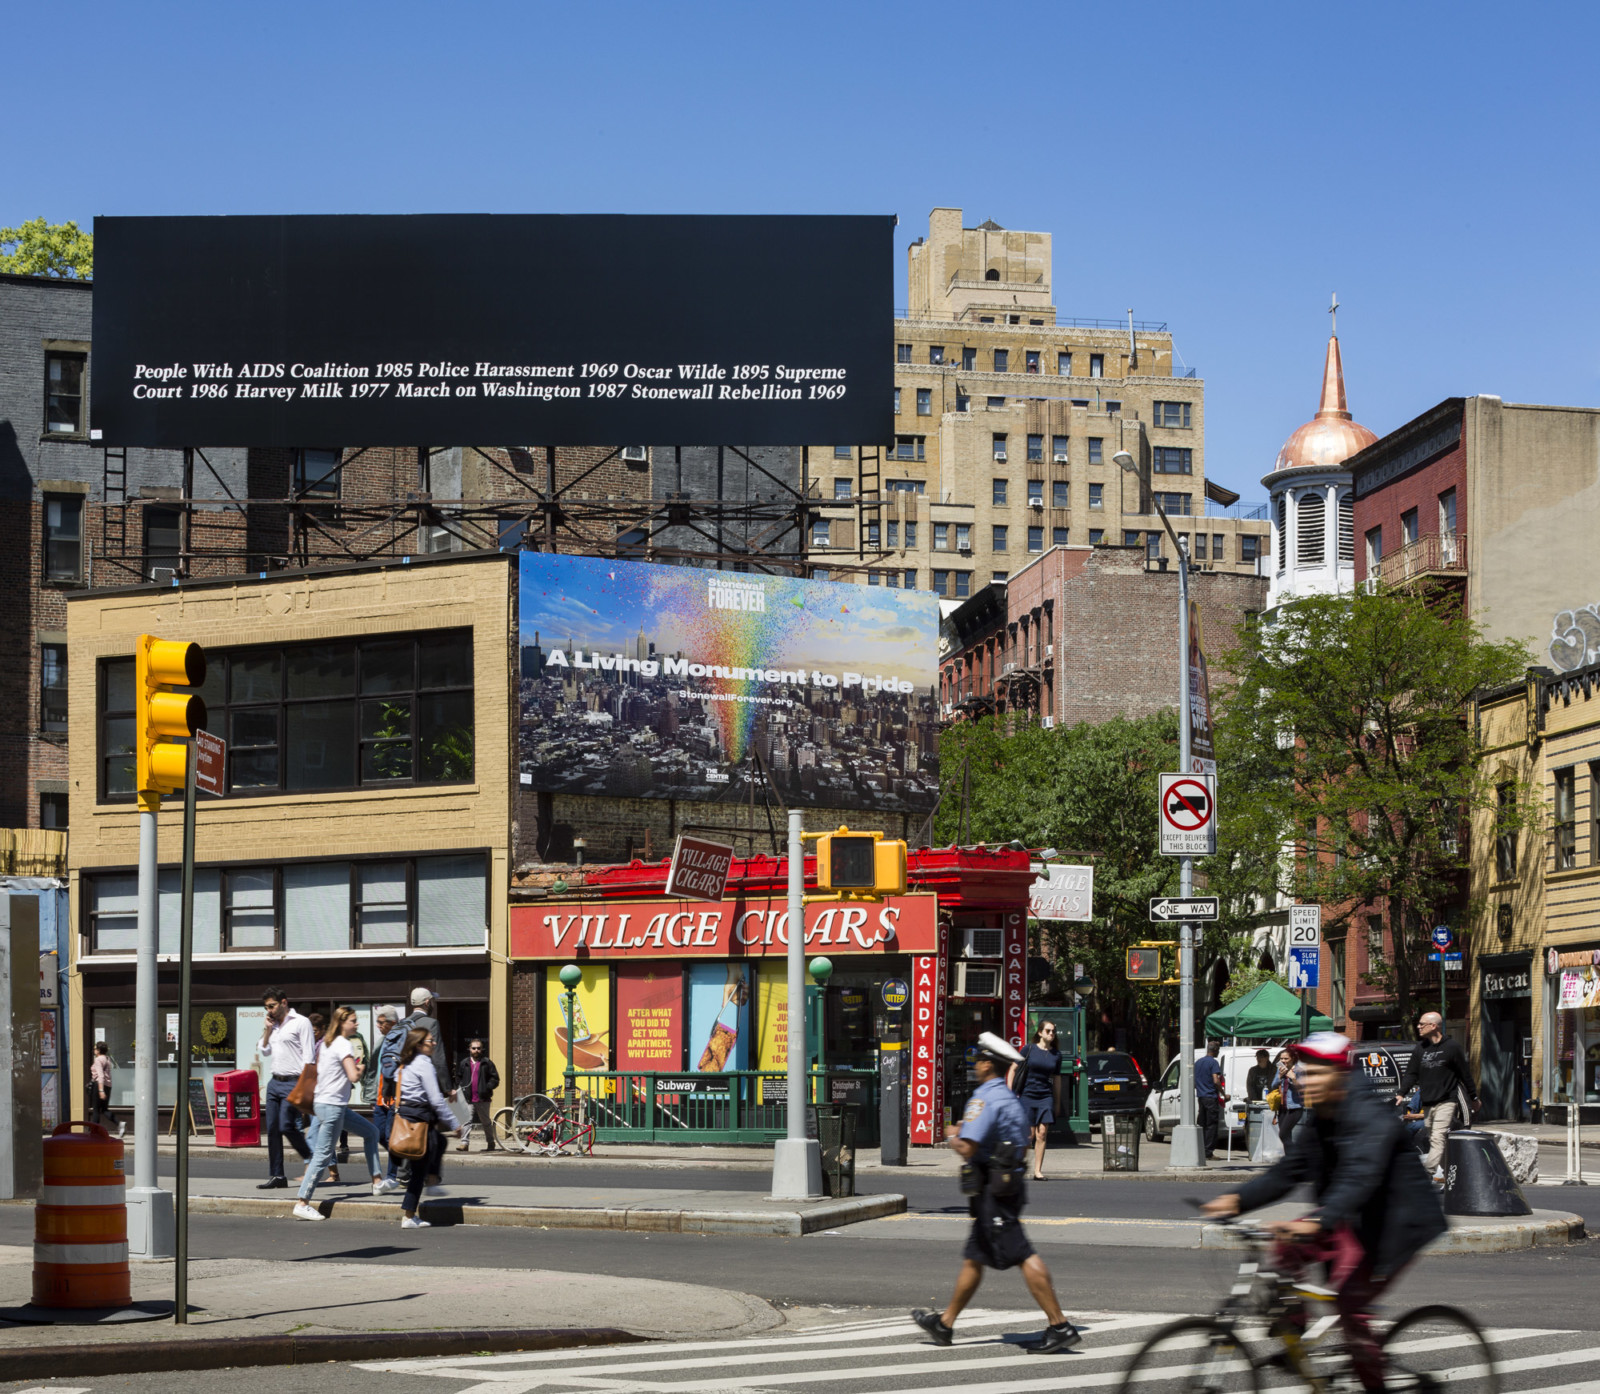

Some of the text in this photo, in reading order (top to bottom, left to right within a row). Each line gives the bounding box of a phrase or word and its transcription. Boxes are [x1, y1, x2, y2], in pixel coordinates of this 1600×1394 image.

[134, 362, 846, 382] People With AIDS Coalition 1985 Police Harassment 1969 Oscar Wilde 1895 Supreme
[133, 383, 846, 401] Court 1986 Harvey Milk 1977 March on Washington 1987 Stonewall Rebellion 1969
[708, 578, 765, 591] Stonewall
[708, 587, 765, 612] FOREVER
[546, 650, 914, 693] A Living Monument to Pride
[679, 690, 793, 707] StonewallForever.org
[682, 848, 729, 873] VILLAGE
[676, 868, 724, 896] CIGARS
[1029, 894, 1081, 912] GARS
[1160, 904, 1211, 914] ONE WAY
[543, 911, 721, 948] VILLAGE
[1294, 927, 1316, 941] 20
[1008, 913, 1022, 1048] CIGAR & CIG
[1485, 972, 1528, 992] fat cat
[628, 1008, 672, 1017] AFTER WHAT
[630, 1019, 670, 1027] YOU DID TO
[632, 1029, 667, 1038] GET YOUR
[935, 929, 946, 1138] CIGAR & CIGARETTE
[628, 1039, 672, 1048] APARTMENT,
[915, 956, 931, 1133] CANDY & SODA
[628, 1049, 672, 1058] WHY LEAVE?
[1363, 1066, 1388, 1077] HAT
[656, 1081, 696, 1091] Subway
[832, 1081, 860, 1090] Christopher St
[832, 1091, 846, 1099] Station
